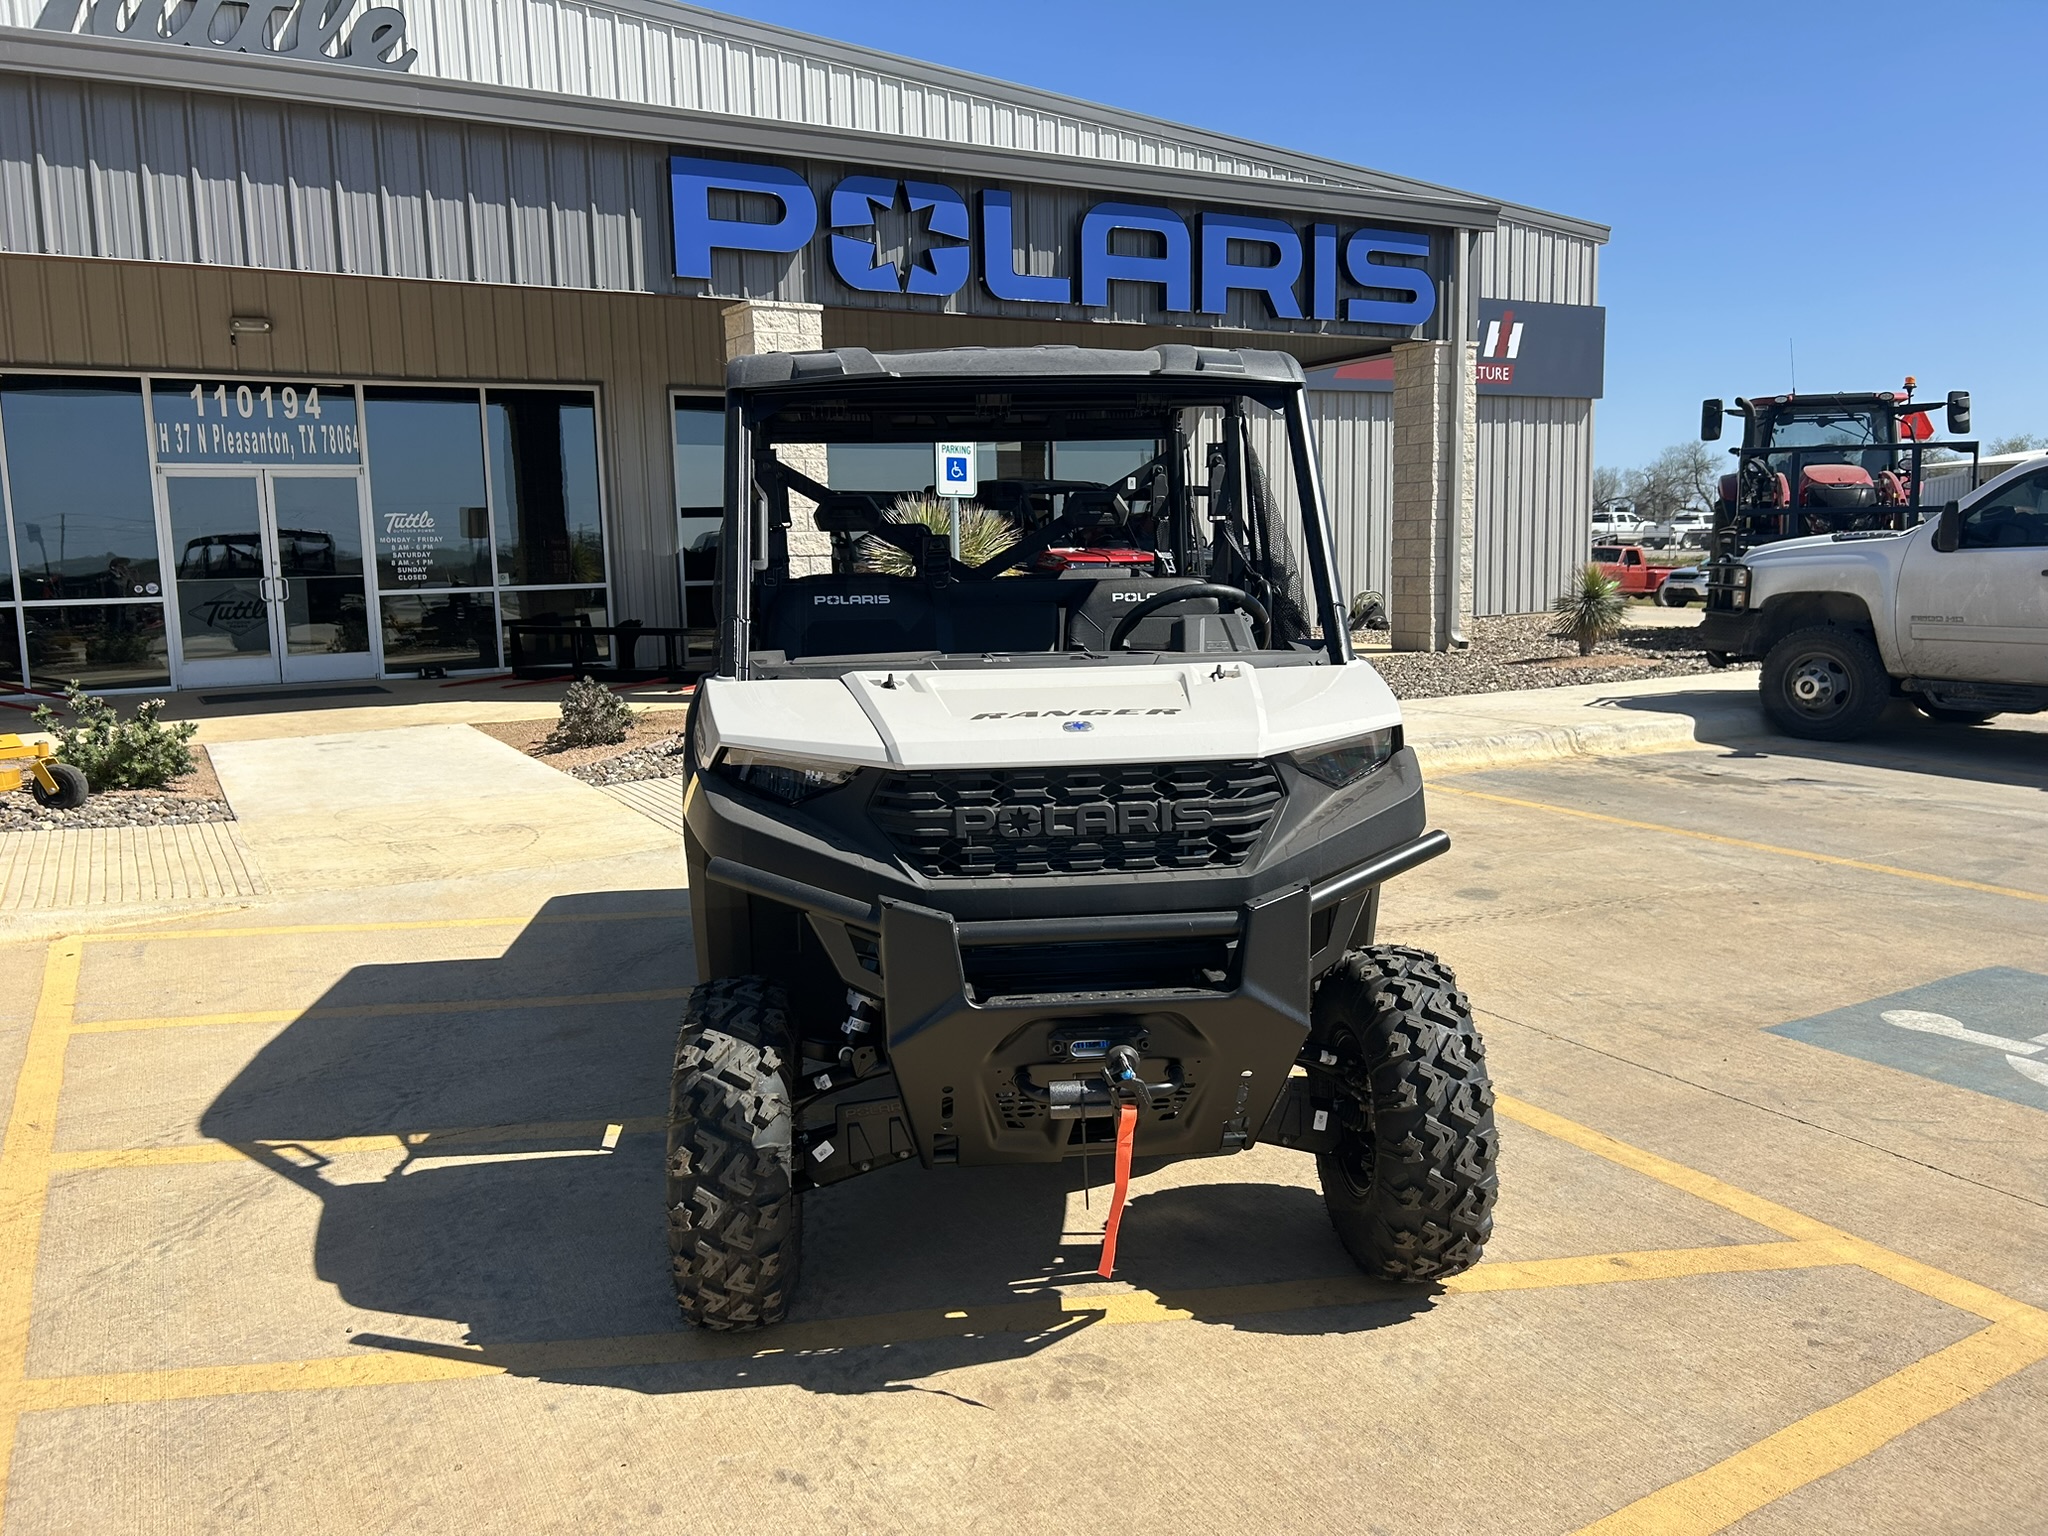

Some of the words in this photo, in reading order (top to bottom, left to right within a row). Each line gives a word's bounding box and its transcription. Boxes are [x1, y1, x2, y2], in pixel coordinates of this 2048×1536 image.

[670, 156, 1436, 326] POLARIS
[190, 384, 321, 419] 110194
[175, 423, 190, 453] 37
[197, 424, 207, 453] N
[212, 424, 295, 460] Pleasanton,
[298, 425, 317, 454] TX
[320, 425, 360, 454] 78064
[941, 444, 972, 455] PARKING
[384, 511, 435, 534] Tuttle
[392, 551, 431, 559] SATURDAY
[814, 594, 891, 605] POLARIS
[970, 709, 1182, 721] RANGER
[955, 800, 1213, 839] POLARIS
